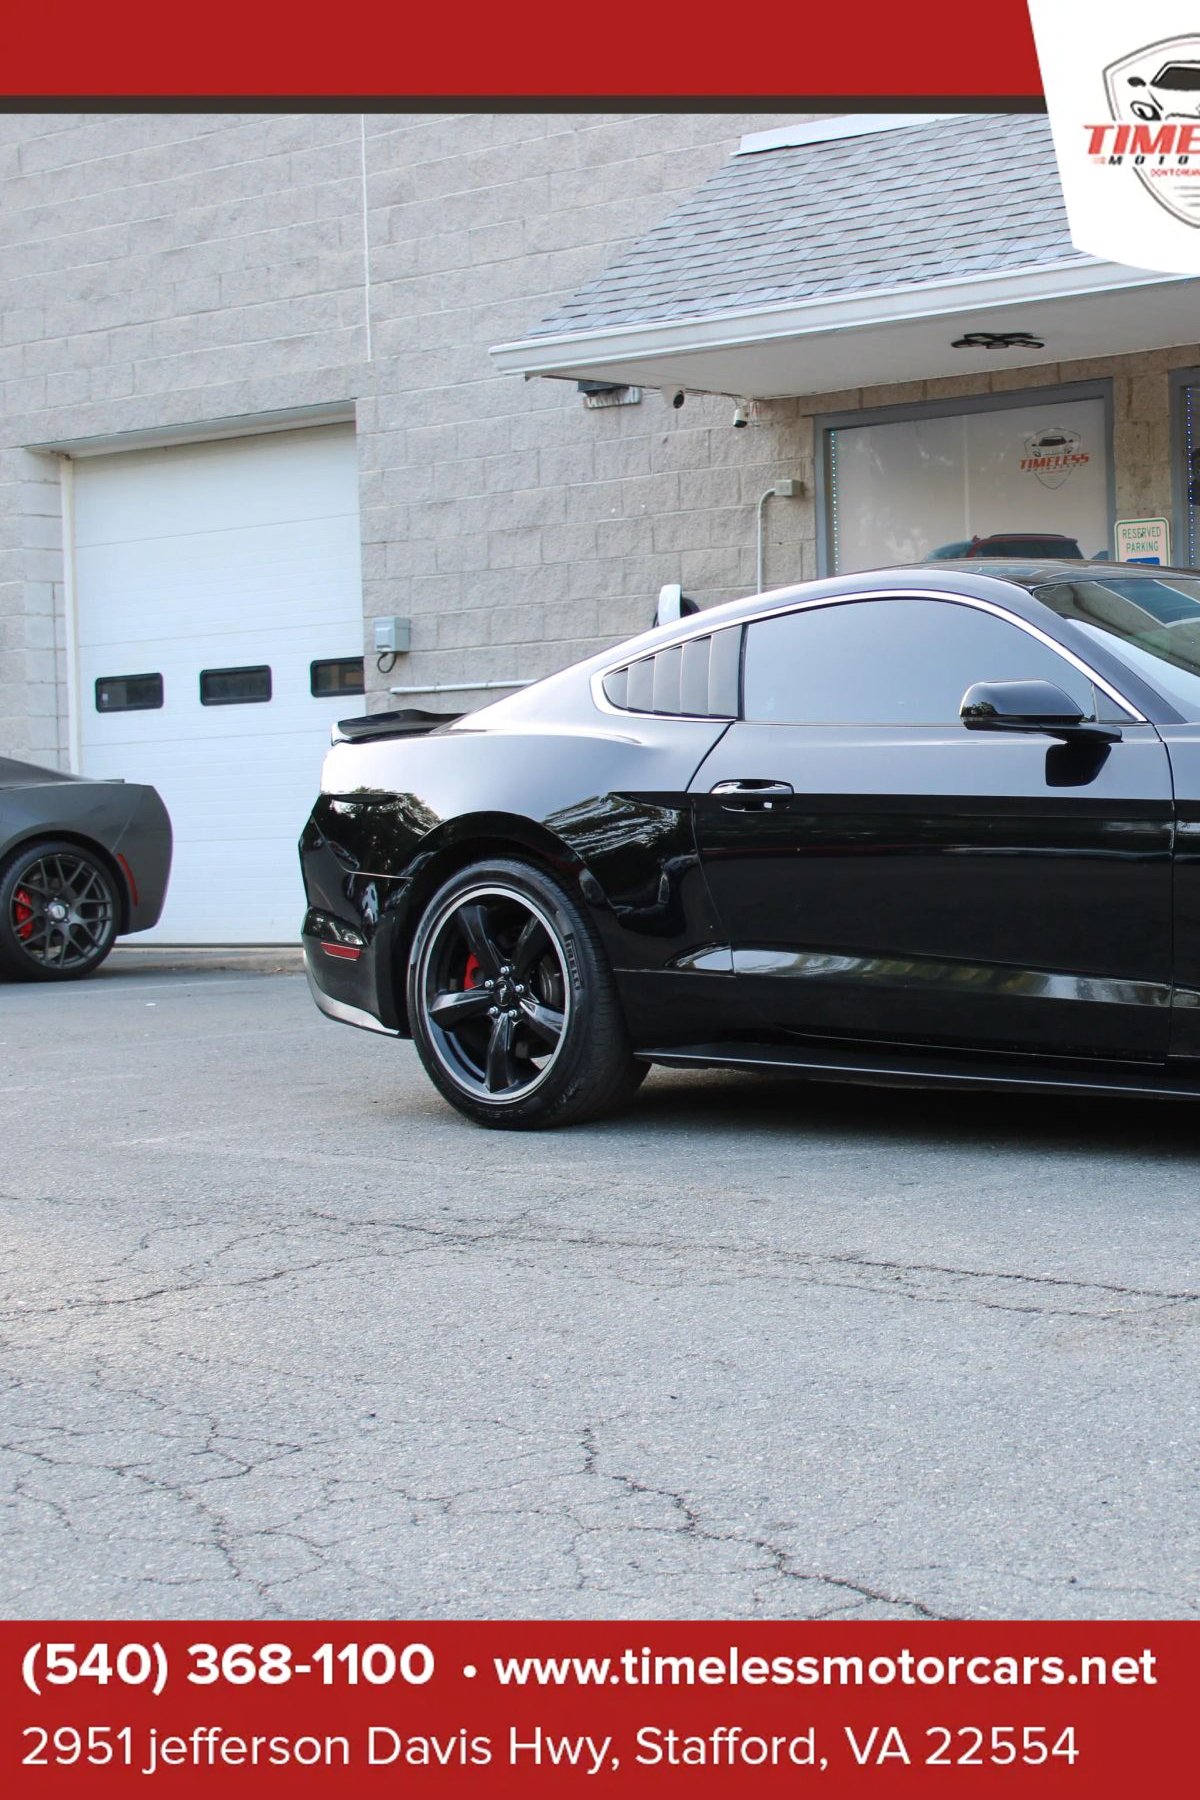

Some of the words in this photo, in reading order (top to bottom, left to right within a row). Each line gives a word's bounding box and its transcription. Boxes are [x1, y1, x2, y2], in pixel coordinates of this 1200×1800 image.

[1019, 453, 1090, 470] TIMELESS
[1122, 526, 1161, 540] RESERVED
[1126, 540, 1159, 553] PARKING
